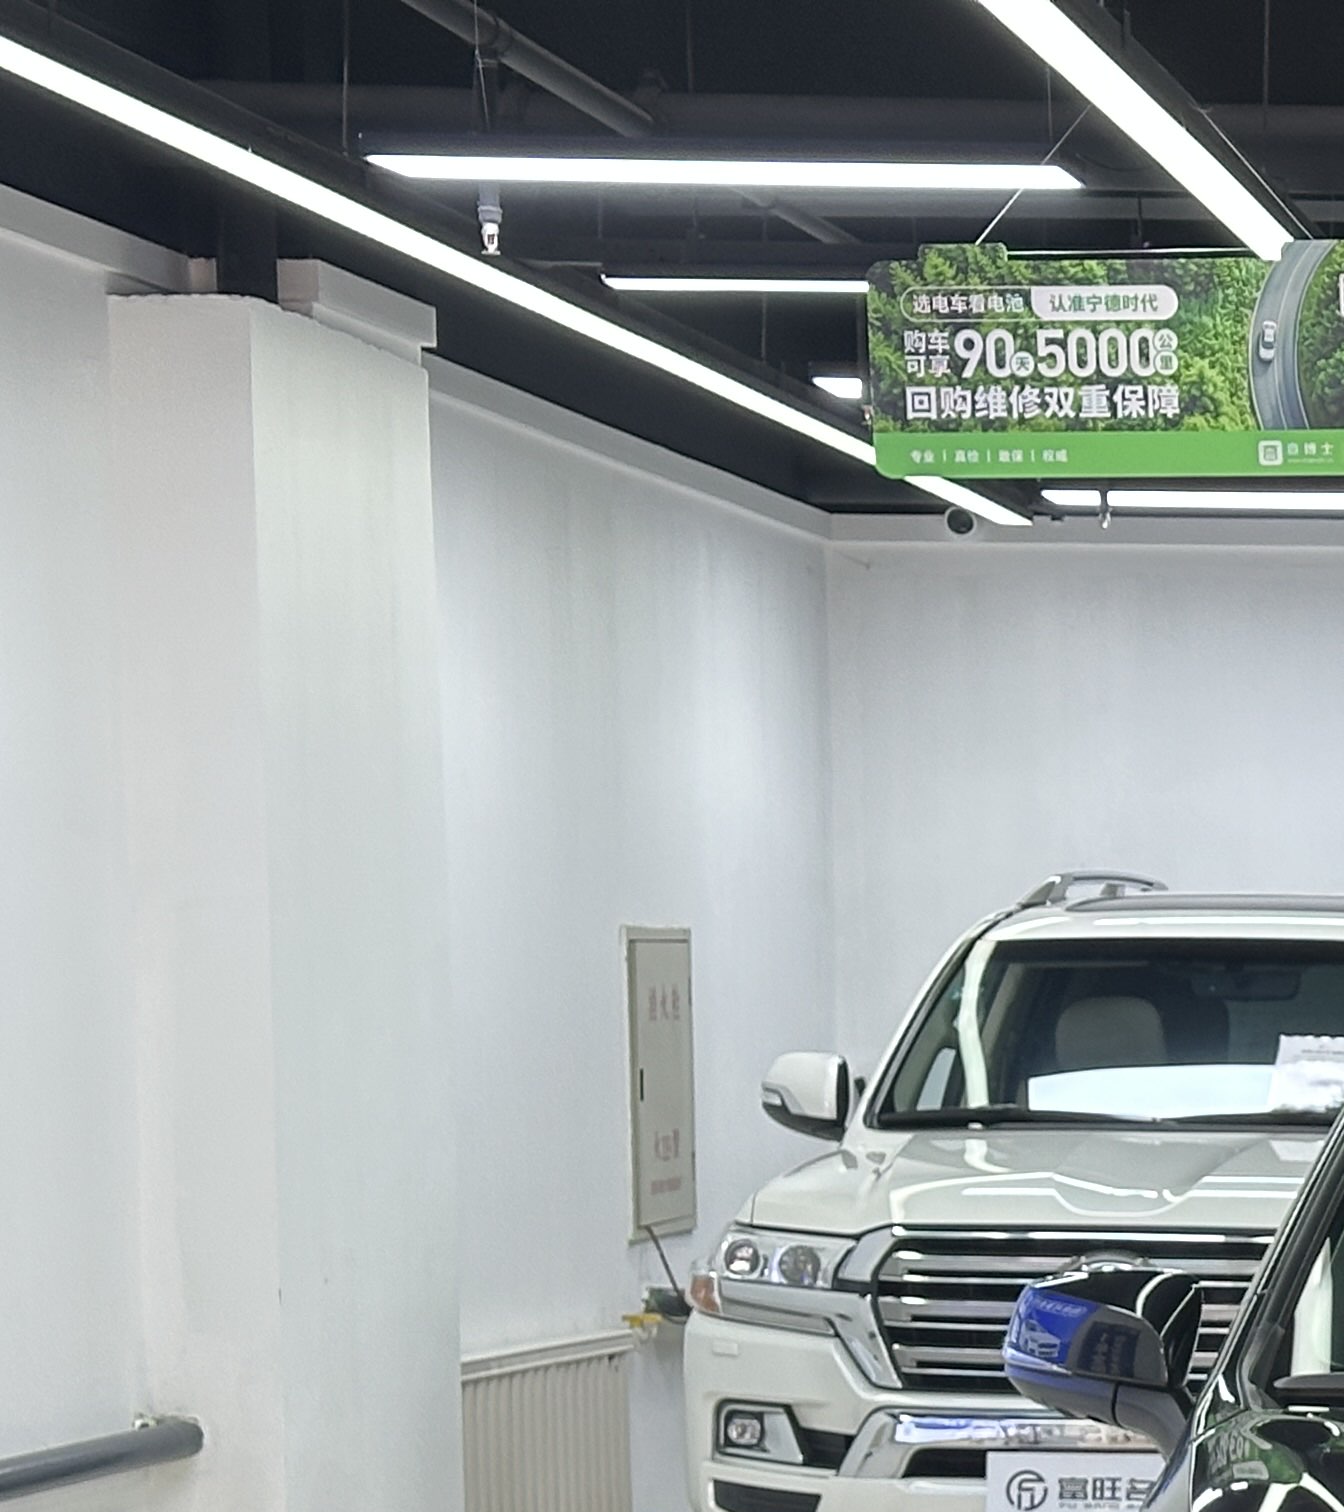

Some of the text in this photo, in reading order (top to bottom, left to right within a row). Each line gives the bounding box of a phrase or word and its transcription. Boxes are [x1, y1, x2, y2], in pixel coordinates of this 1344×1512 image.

[911, 292, 1159, 314] 选电车看电池 认准宁德时代
[903, 329, 950, 354] 购车
[904, 354, 951, 378] 可享
[904, 384, 1181, 420] 回购维修双重保障
